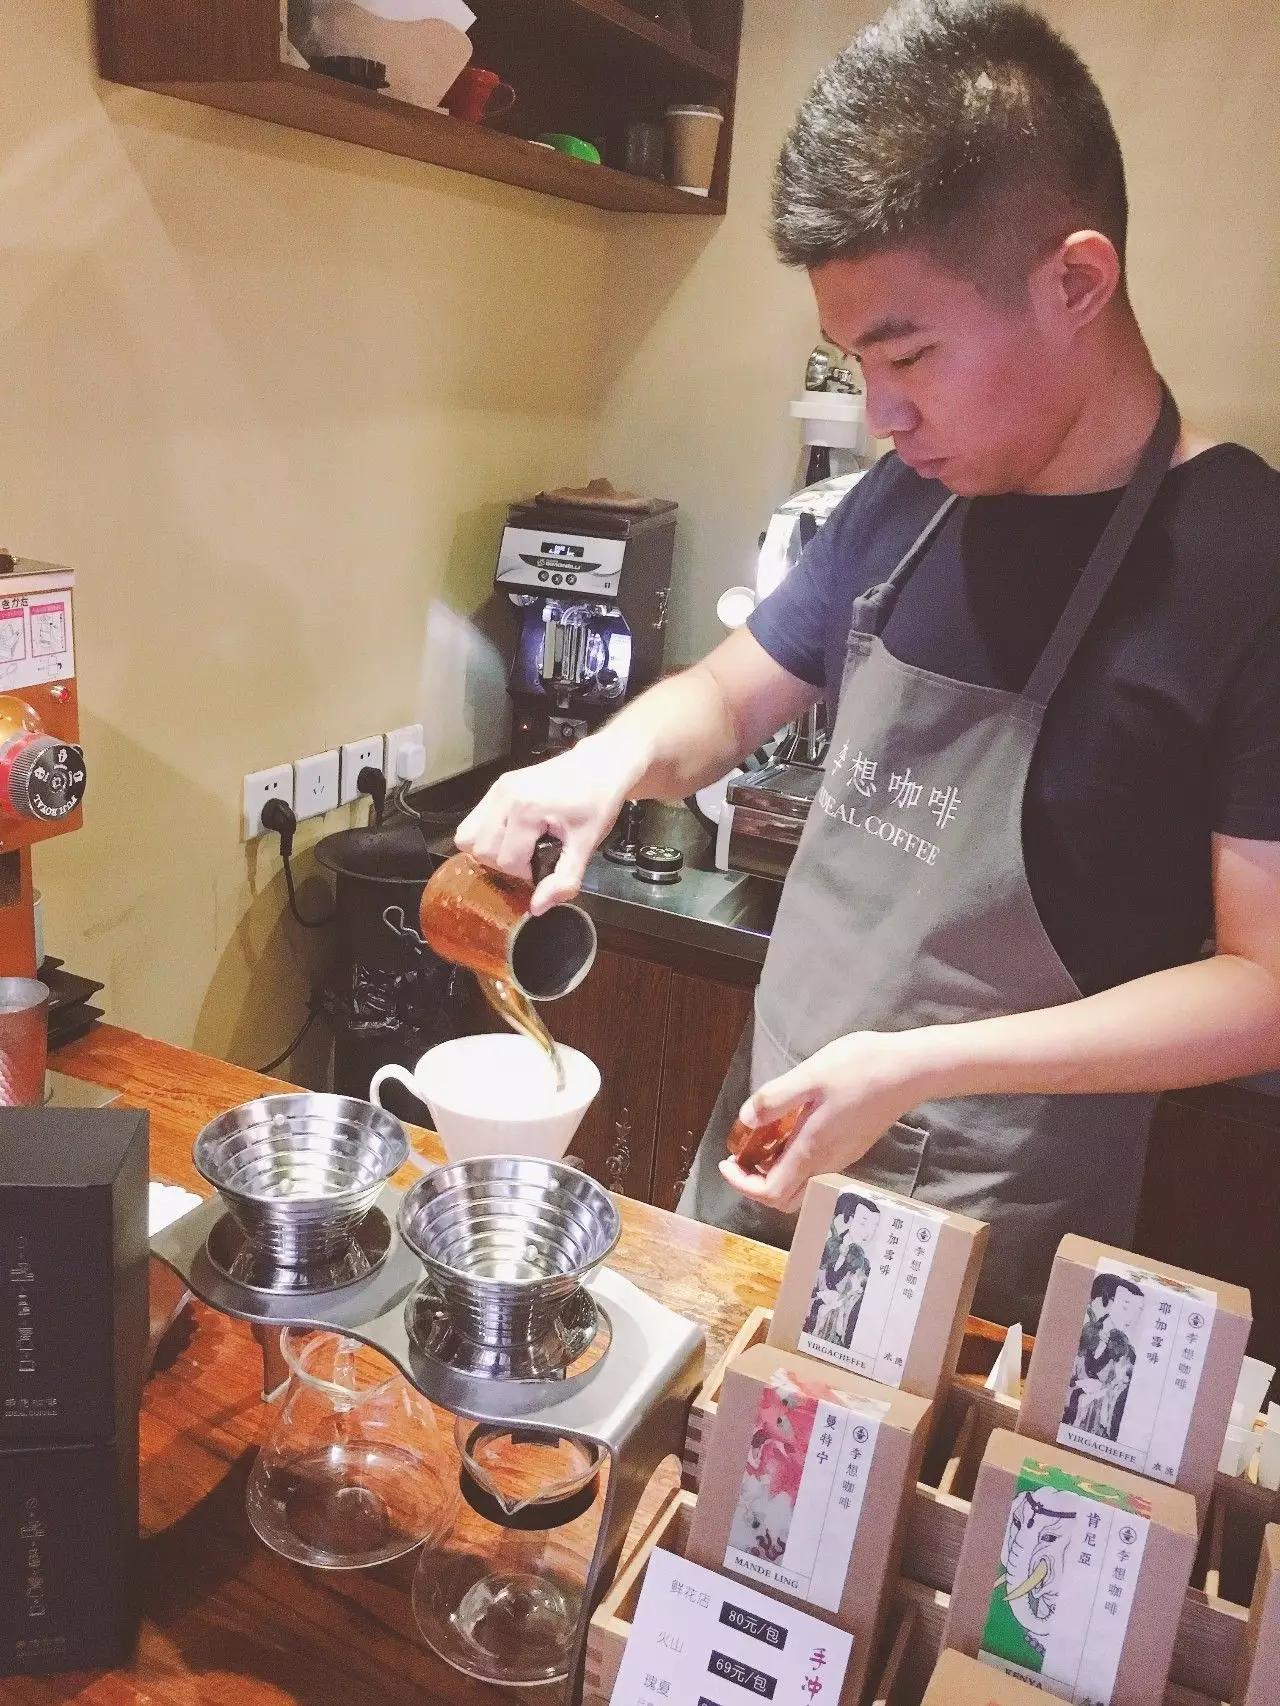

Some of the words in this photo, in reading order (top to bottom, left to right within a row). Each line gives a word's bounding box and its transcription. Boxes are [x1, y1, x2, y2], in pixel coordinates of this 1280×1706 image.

[864, 815, 941, 867] COFFEE
[902, 1246, 926, 1300] 李想咖啡
[806, 1340, 867, 1370] YIRGACHEFFE
[1174, 1332, 1199, 1391] 李想咖啡
[816, 1414, 838, 1465] 曼特宁
[1067, 1432, 1137, 1464] YIRGACHEFFE
[838, 1447, 863, 1510] 李想咖啡
[1077, 1511, 1101, 1567] 肯尼亞
[734, 1556, 772, 1578] MANDE
[773, 1572, 800, 1590] LING
[1104, 1549, 1130, 1617] 李想咖啡
[656, 1631, 685, 1654] 火山
[728, 1609, 780, 1645] 80元/包
[715, 1657, 768, 1694] 69元/包
